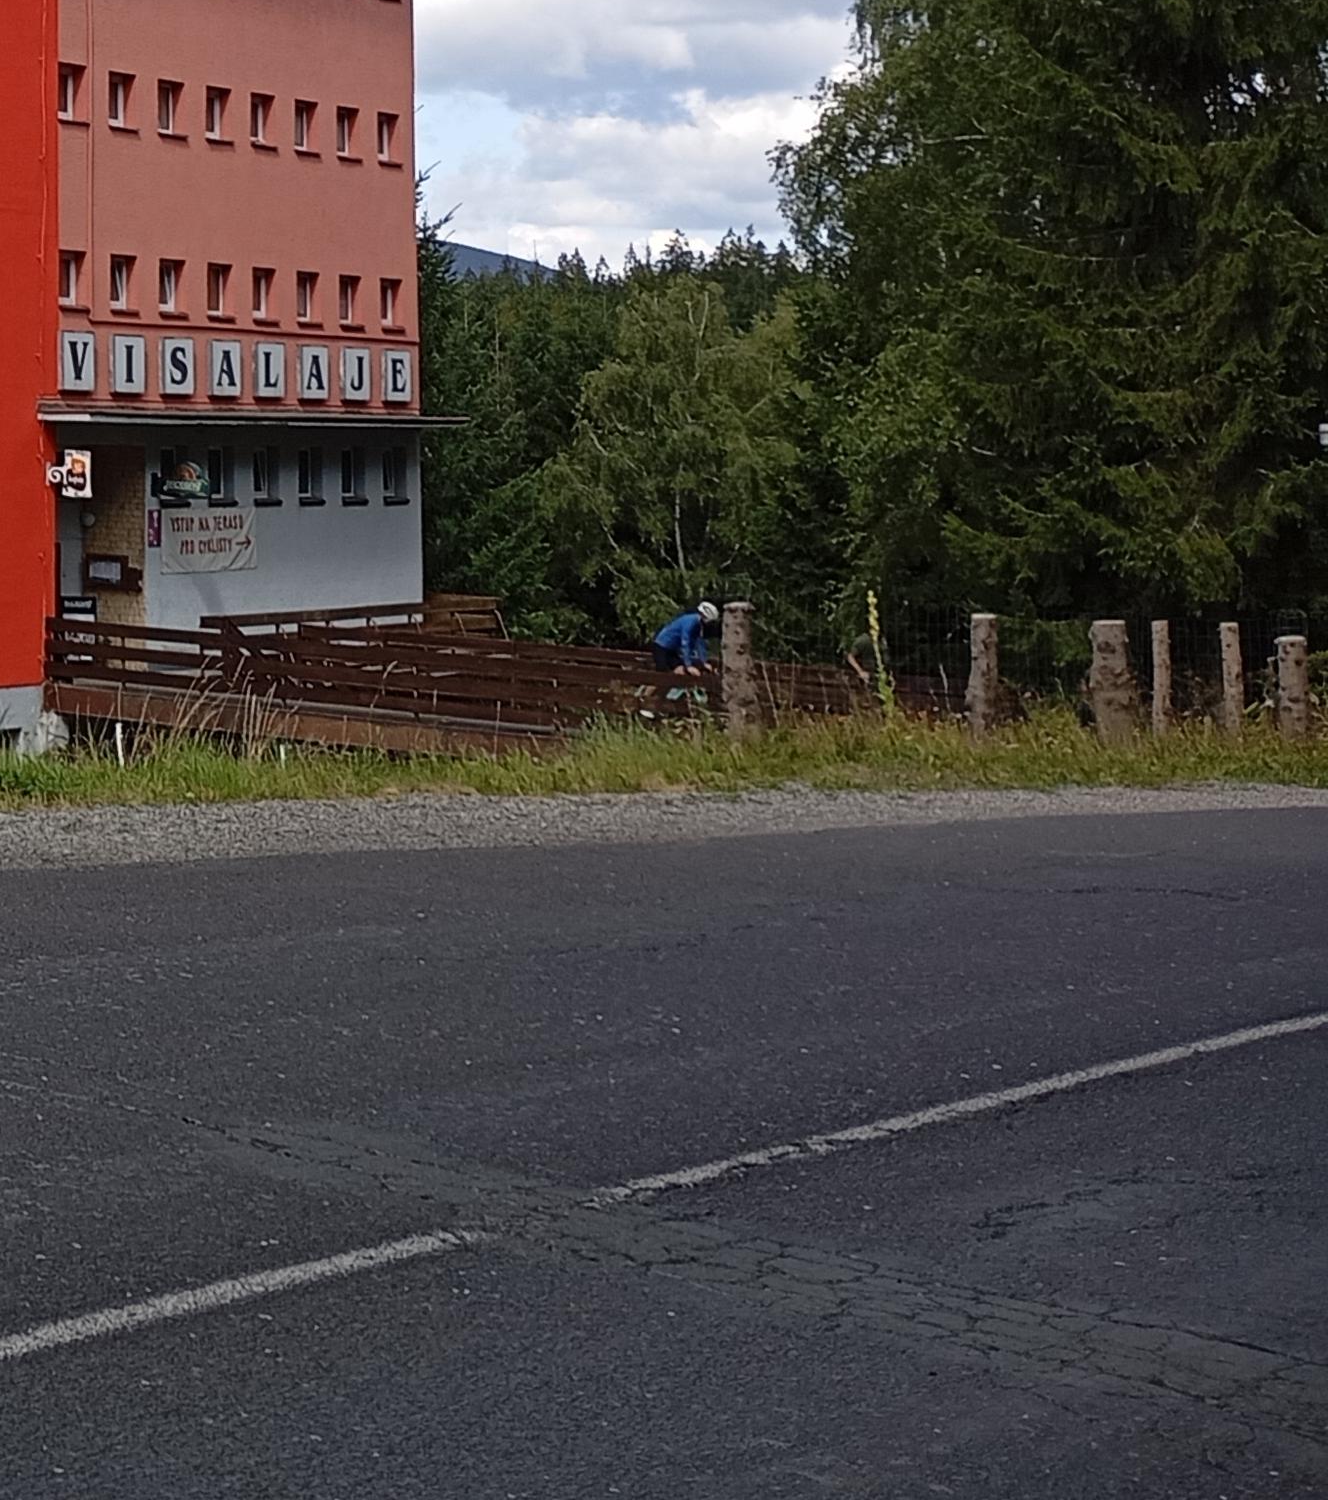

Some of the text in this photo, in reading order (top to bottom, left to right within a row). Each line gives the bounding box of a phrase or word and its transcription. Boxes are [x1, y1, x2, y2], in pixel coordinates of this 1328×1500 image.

[67, 340, 407, 394] VISALAJE
[170, 516, 195, 533] VSTUP
[198, 516, 210, 532] NA
[179, 537, 233, 555] PRO CYKLISTY
